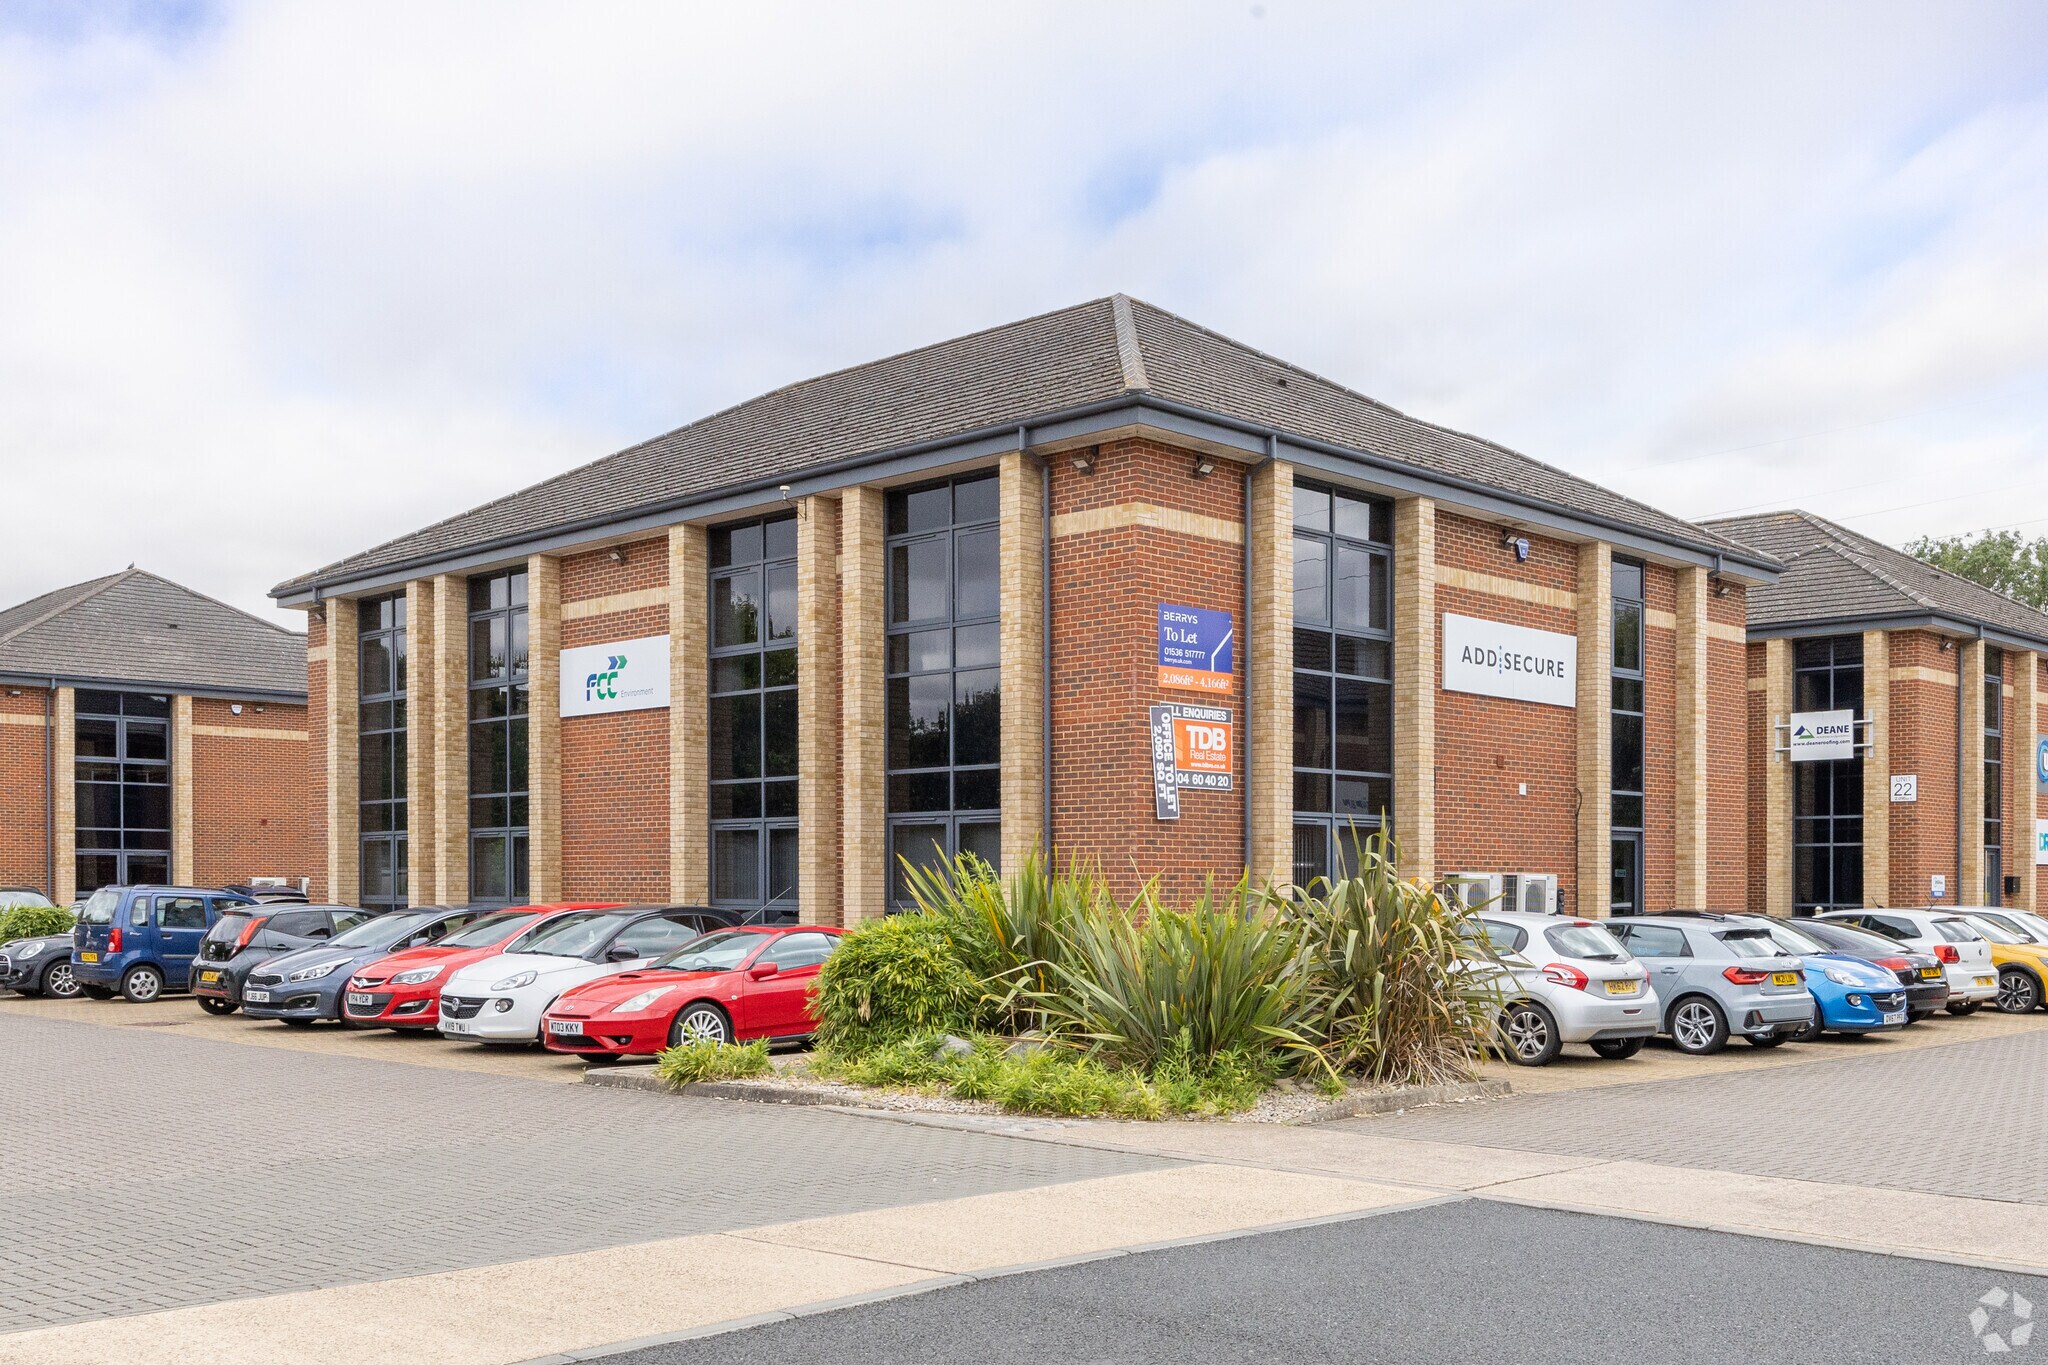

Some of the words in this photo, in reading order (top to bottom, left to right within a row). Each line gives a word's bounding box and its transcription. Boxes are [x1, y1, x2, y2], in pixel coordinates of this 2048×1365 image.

[1163, 611, 1198, 624] BERRYS
[1164, 626, 1178, 642] To
[1180, 629, 1198, 644] Let
[1164, 647, 1183, 657] 01536
[1184, 649, 1206, 659] 517777
[620, 687, 654, 698] Environment
[1183, 707, 1227, 721] ENQUIRIES
[1161, 712, 1173, 761] OFFICE
[1816, 725, 1850, 735] DEANE
[1153, 725, 1163, 759] 2,090
[1186, 724, 1226, 751] TDB
[1190, 749, 1205, 760] Real
[1206, 751, 1226, 762] Estate
[1156, 762, 1165, 780] SQ
[1164, 764, 1175, 784] TO
[1192, 774, 1204, 785] 60
[1205, 775, 1216, 786] 40
[1217, 775, 1229, 787] 20
[1158, 783, 1166, 800] FT
[1894, 782, 1912, 796] 22
[1166, 786, 1176, 812] LET
[565, 1023, 579, 1033] KKY
